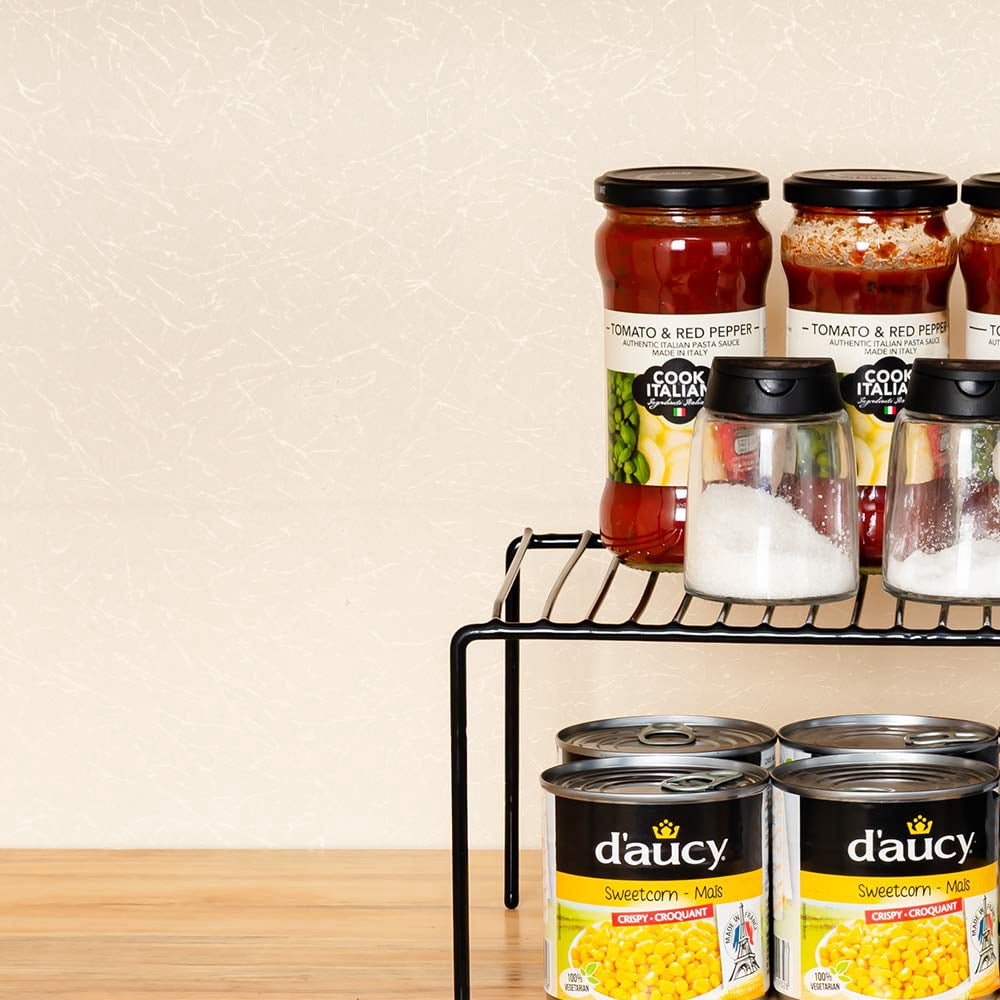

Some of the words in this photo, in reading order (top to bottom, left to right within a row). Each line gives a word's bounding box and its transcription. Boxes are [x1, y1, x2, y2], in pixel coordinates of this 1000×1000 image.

[611, 323, 656, 338] TOMATO
[662, 328, 671, 338] &
[676, 327, 704, 338] RED
[710, 323, 752, 338] PEPPER
[812, 323, 869, 337] TOMATO
[875, 326, 884, 338] &
[890, 325, 914, 337] RED
[919, 321, 947, 335] PEPPER
[623, 339, 659, 348] AUTHENTIC
[660, 340, 690, 348] ITALIAN
[692, 340, 716, 348] PASTA
[718, 338, 740, 347] SAUCE
[829, 339, 871, 347] AUTHENTIC
[925, 337, 940, 345] SAUCE
[653, 371, 705, 384] COOK
[857, 382, 908, 396] ITALIA
[595, 832, 728, 871] d'aucy
[847, 829, 975, 864] d'aucy
[605, 886, 678, 901] Sweetcorn
[858, 884, 931, 897] Sweetcorn
[618, 914, 648, 923] CRISPY
[655, 908, 708, 922] CROQUANT
[872, 911, 902, 921] CRISPY
[909, 902, 958, 917] CROQUANT
[725, 923, 734, 944] MADE
[815, 972, 832, 981] 100%
